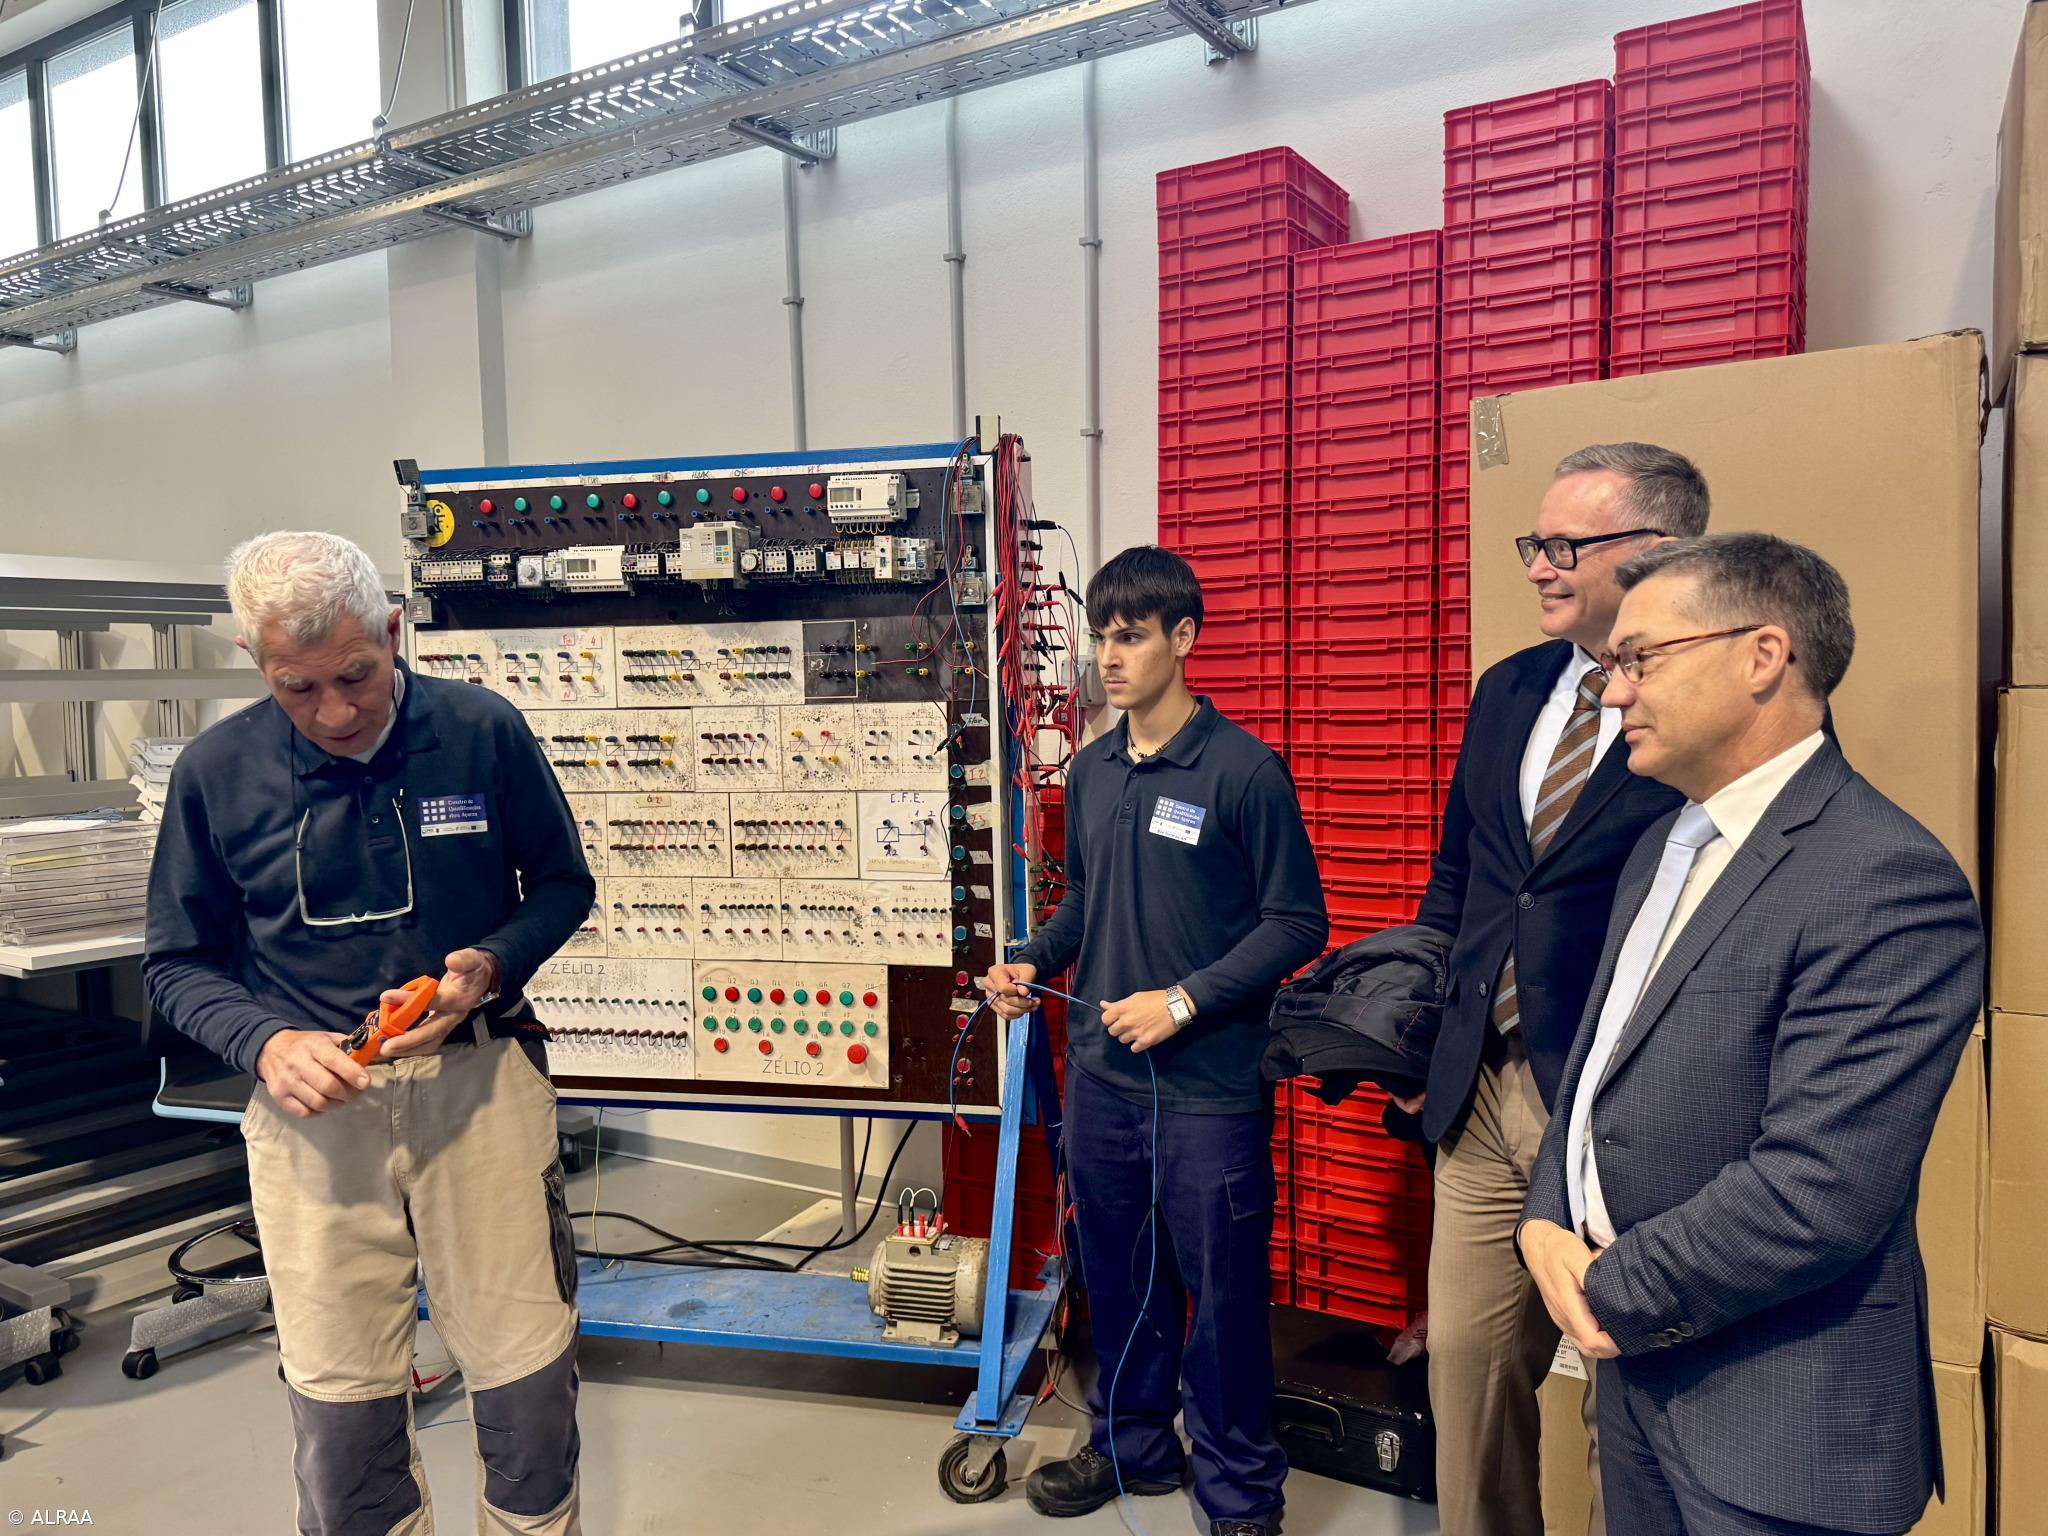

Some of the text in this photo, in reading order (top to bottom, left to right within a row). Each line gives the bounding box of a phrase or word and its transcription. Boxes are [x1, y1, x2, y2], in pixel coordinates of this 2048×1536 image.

[598, 964, 606, 974] 2
[762, 1055, 824, 1076] ZÉLIO 2
